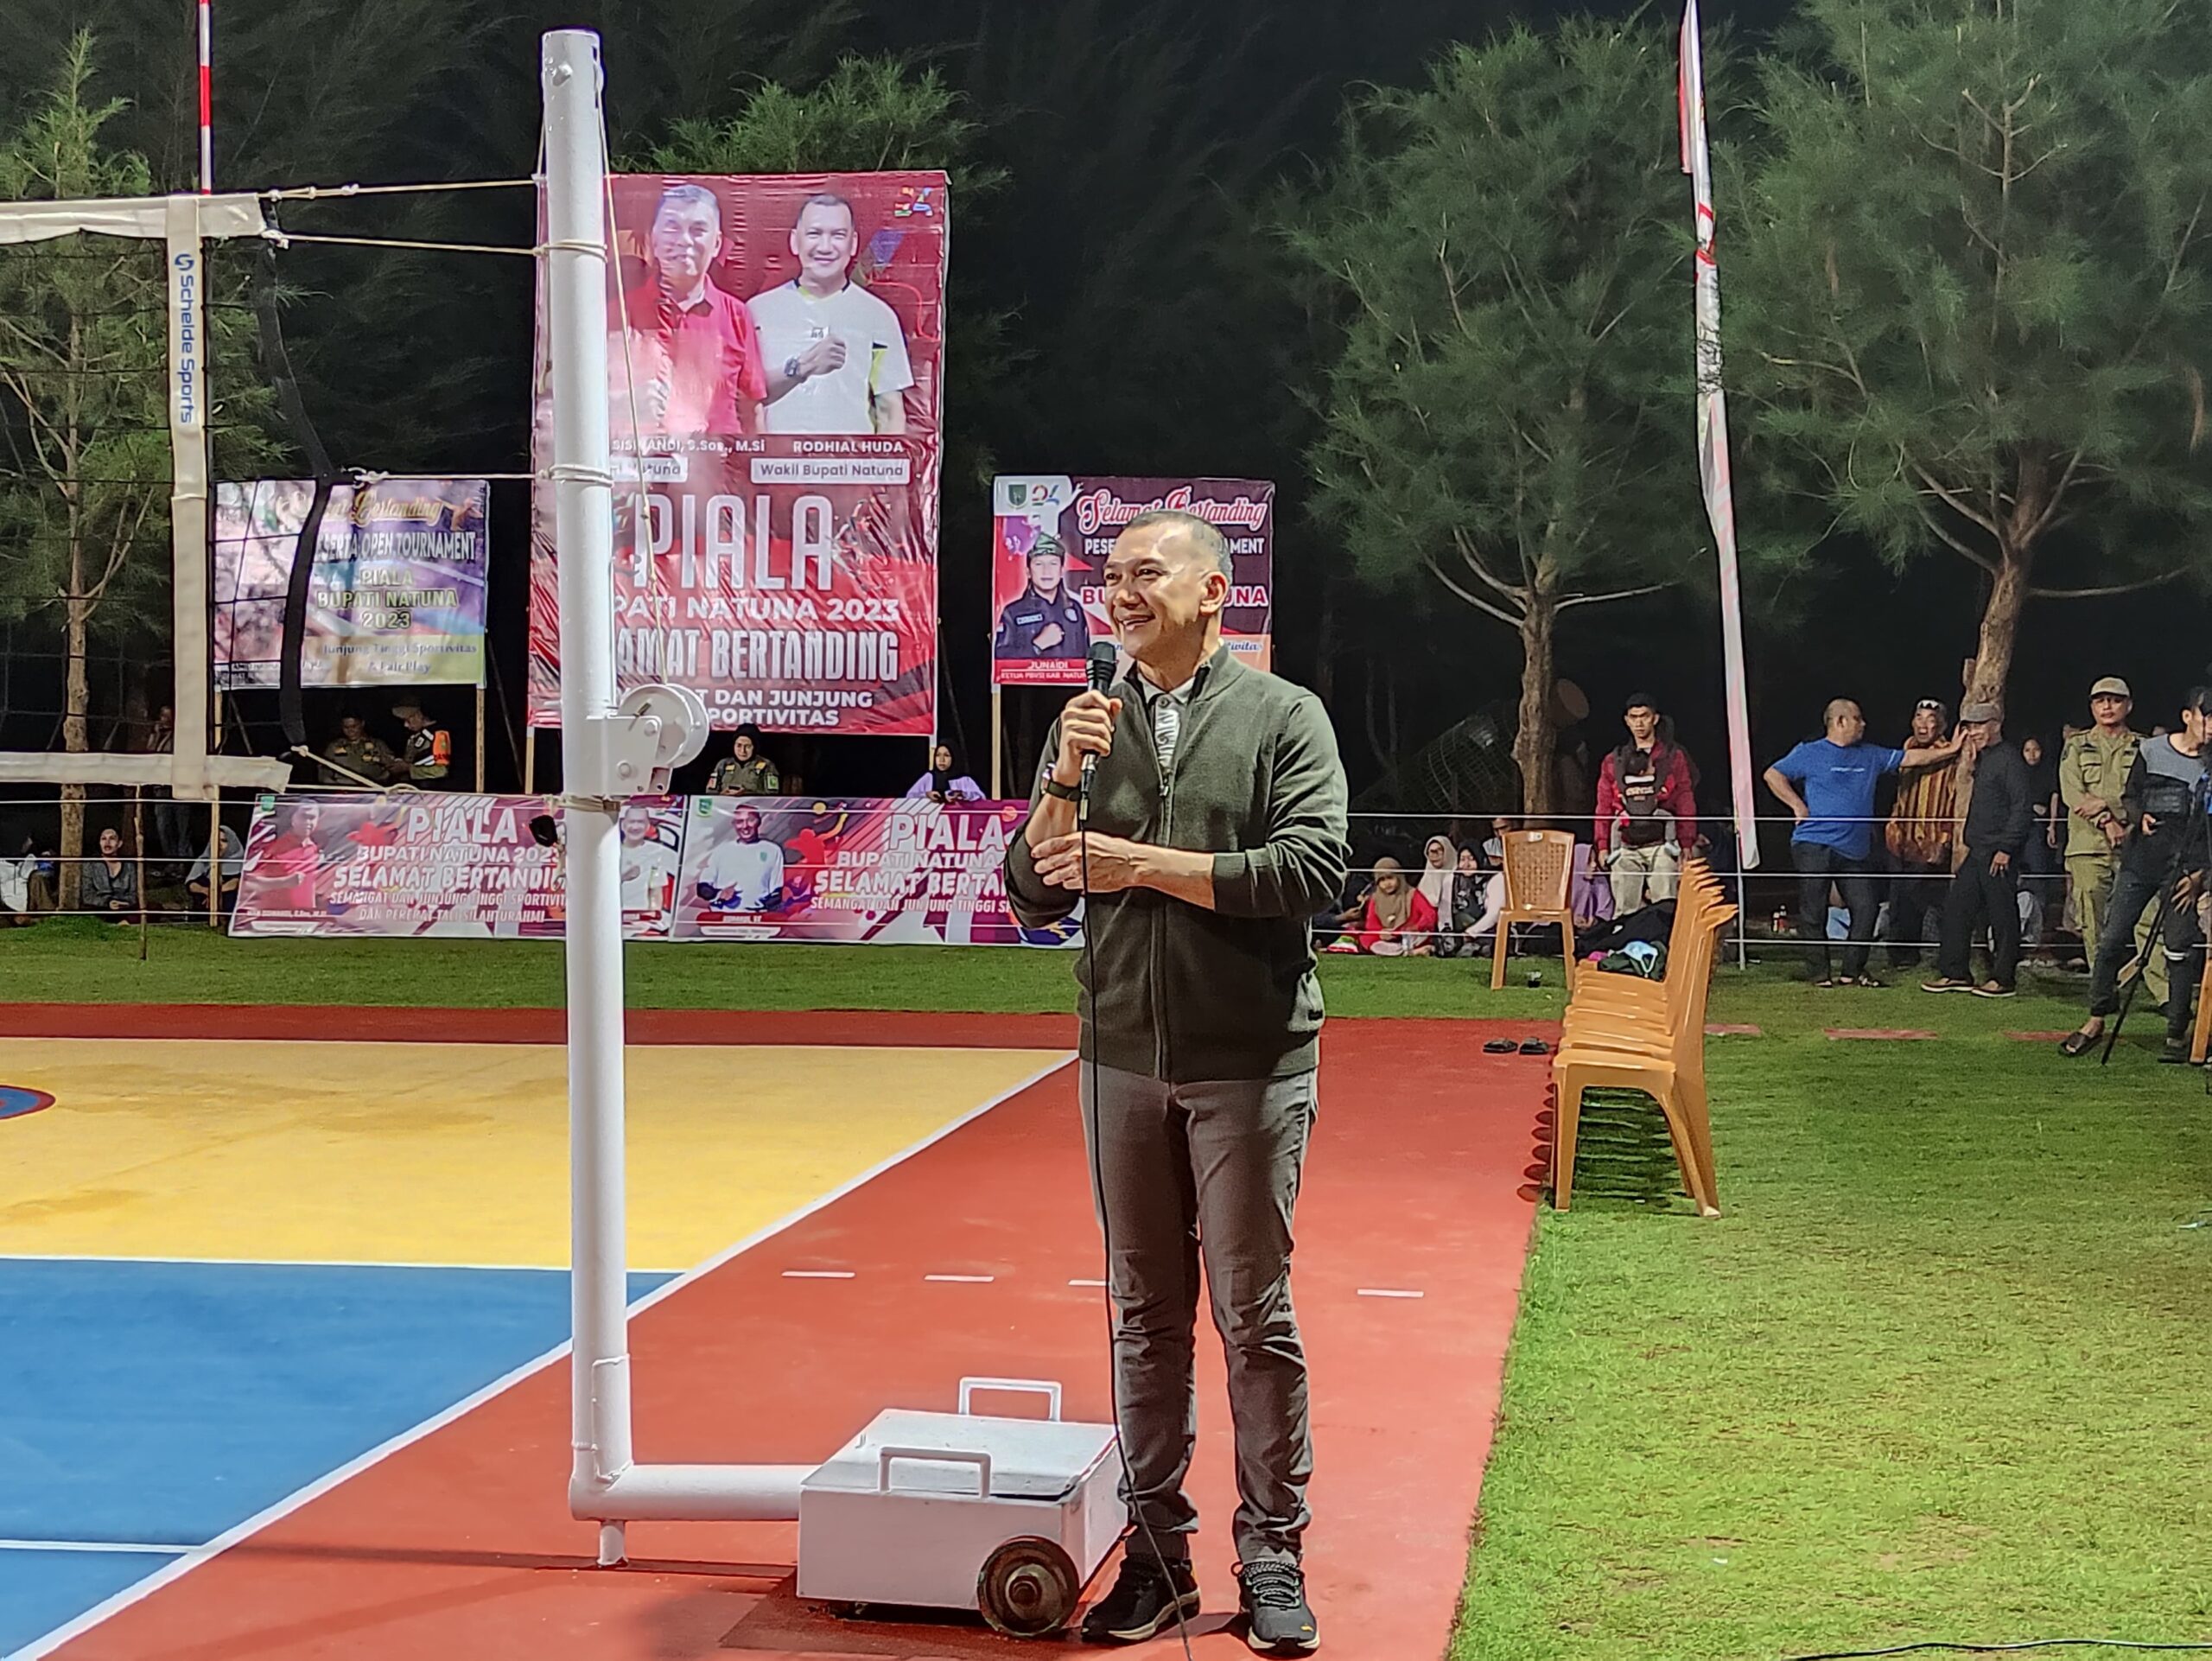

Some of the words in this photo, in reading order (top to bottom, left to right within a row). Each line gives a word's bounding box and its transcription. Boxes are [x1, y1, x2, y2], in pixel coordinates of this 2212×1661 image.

[181, 274, 194, 354] Schelde
[176, 358, 195, 423] Sports
[735, 438, 766, 453] M.Si
[792, 441, 858, 454] RODHIAL
[861, 441, 905, 454] HUDA
[760, 463, 799, 476] Wakil
[803, 463, 848, 480] Bupati
[851, 464, 904, 477] Natuna
[361, 531, 393, 558] OPEN
[397, 531, 476, 561] TOURNAMENT
[632, 493, 834, 591] PIALA
[360, 568, 415, 587] PIALA
[316, 590, 381, 609] BUPATI
[385, 589, 458, 609] NATUNA
[686, 596, 820, 621] NATUNA
[826, 597, 899, 621] 2023
[361, 610, 412, 629] 2023
[617, 628, 701, 677] AMAT
[710, 629, 899, 681] BERTANDING
[1027, 660, 1069, 670] JUNAIDI
[714, 689, 763, 706] DAN
[767, 690, 874, 708] JUNJUNG
[709, 707, 840, 727] PORTIVITAS
[406, 806, 518, 844] PIALA
[889, 813, 1006, 851] PIALA
[356, 845, 426, 862] BUPATI
[429, 846, 511, 863] NATUNA
[837, 850, 907, 869] BUPATI
[912, 851, 1000, 869] NATUNA
[334, 865, 435, 889] SELAMAT
[814, 869, 918, 896] SELAMAT
[810, 895, 874, 910] SEMANGAT
[875, 897, 899, 911] DAN
[957, 899, 996, 913] TINGGI
[359, 908, 382, 921] DAN
